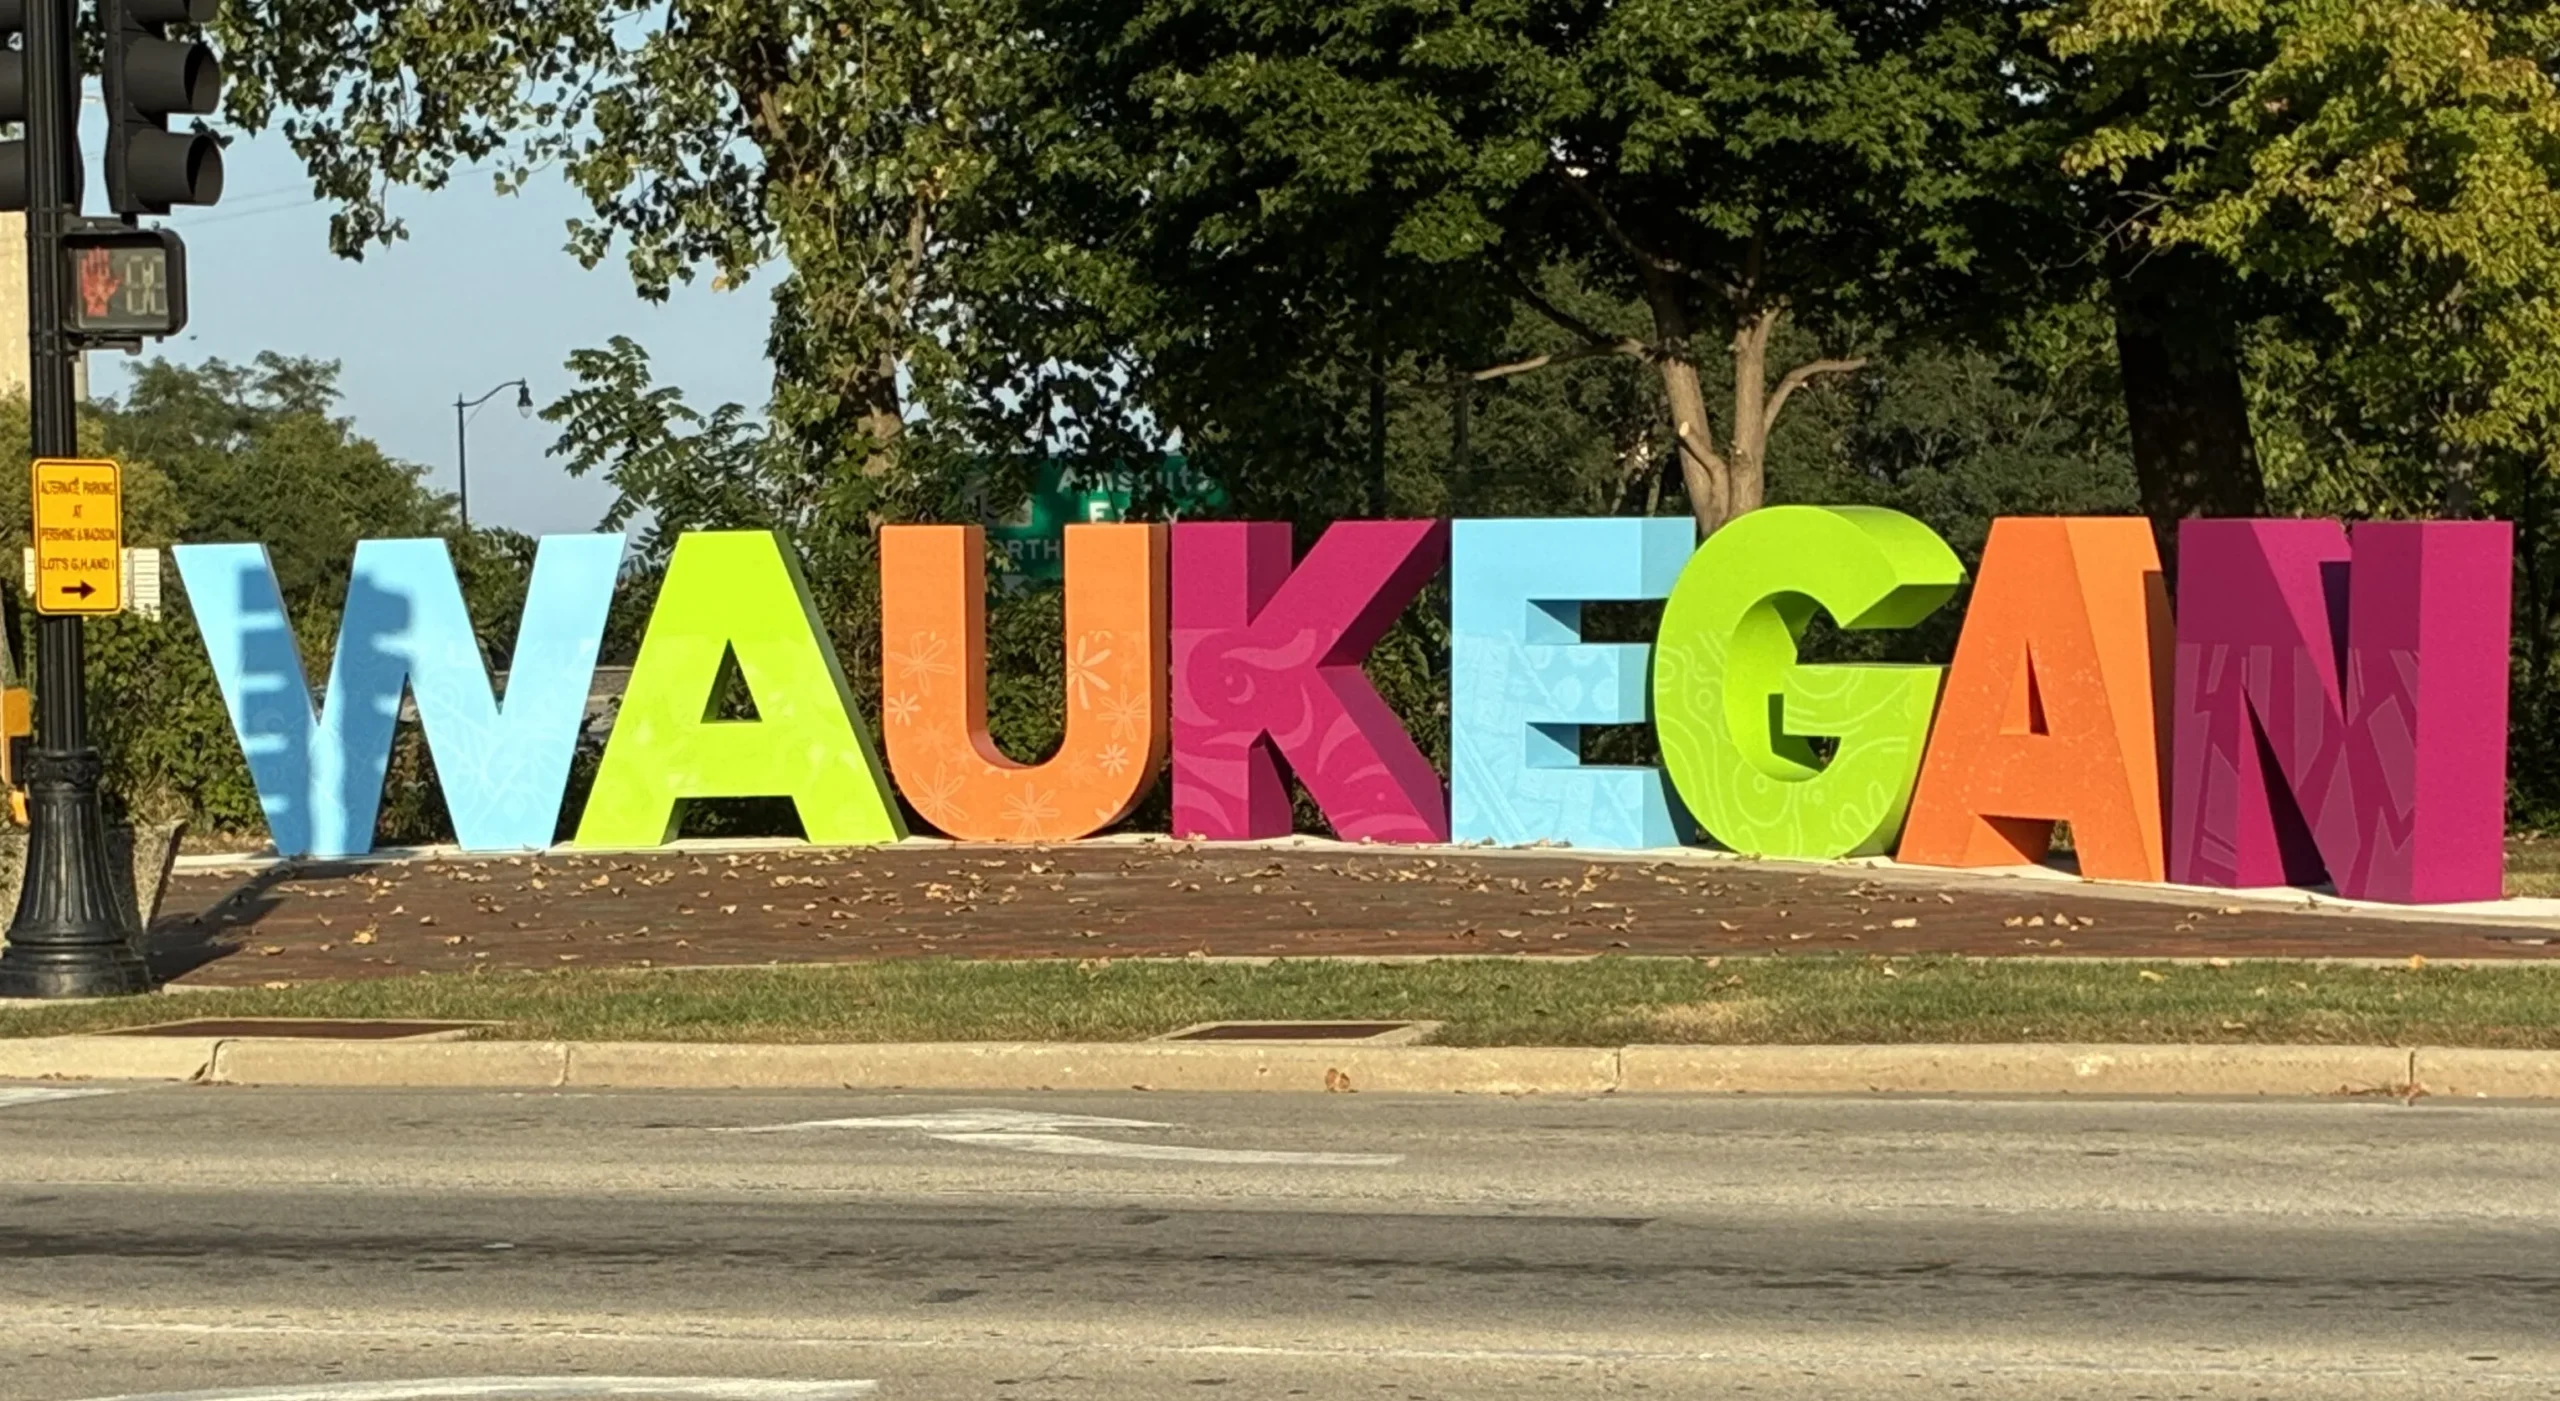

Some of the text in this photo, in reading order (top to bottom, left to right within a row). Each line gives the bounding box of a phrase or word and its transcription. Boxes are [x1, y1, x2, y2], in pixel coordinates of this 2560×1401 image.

[83, 481, 115, 496] PARKING
[72, 504, 83, 518] AT
[83, 527, 115, 541] MADISON
[173, 505, 2514, 904] WAUKEGAN
